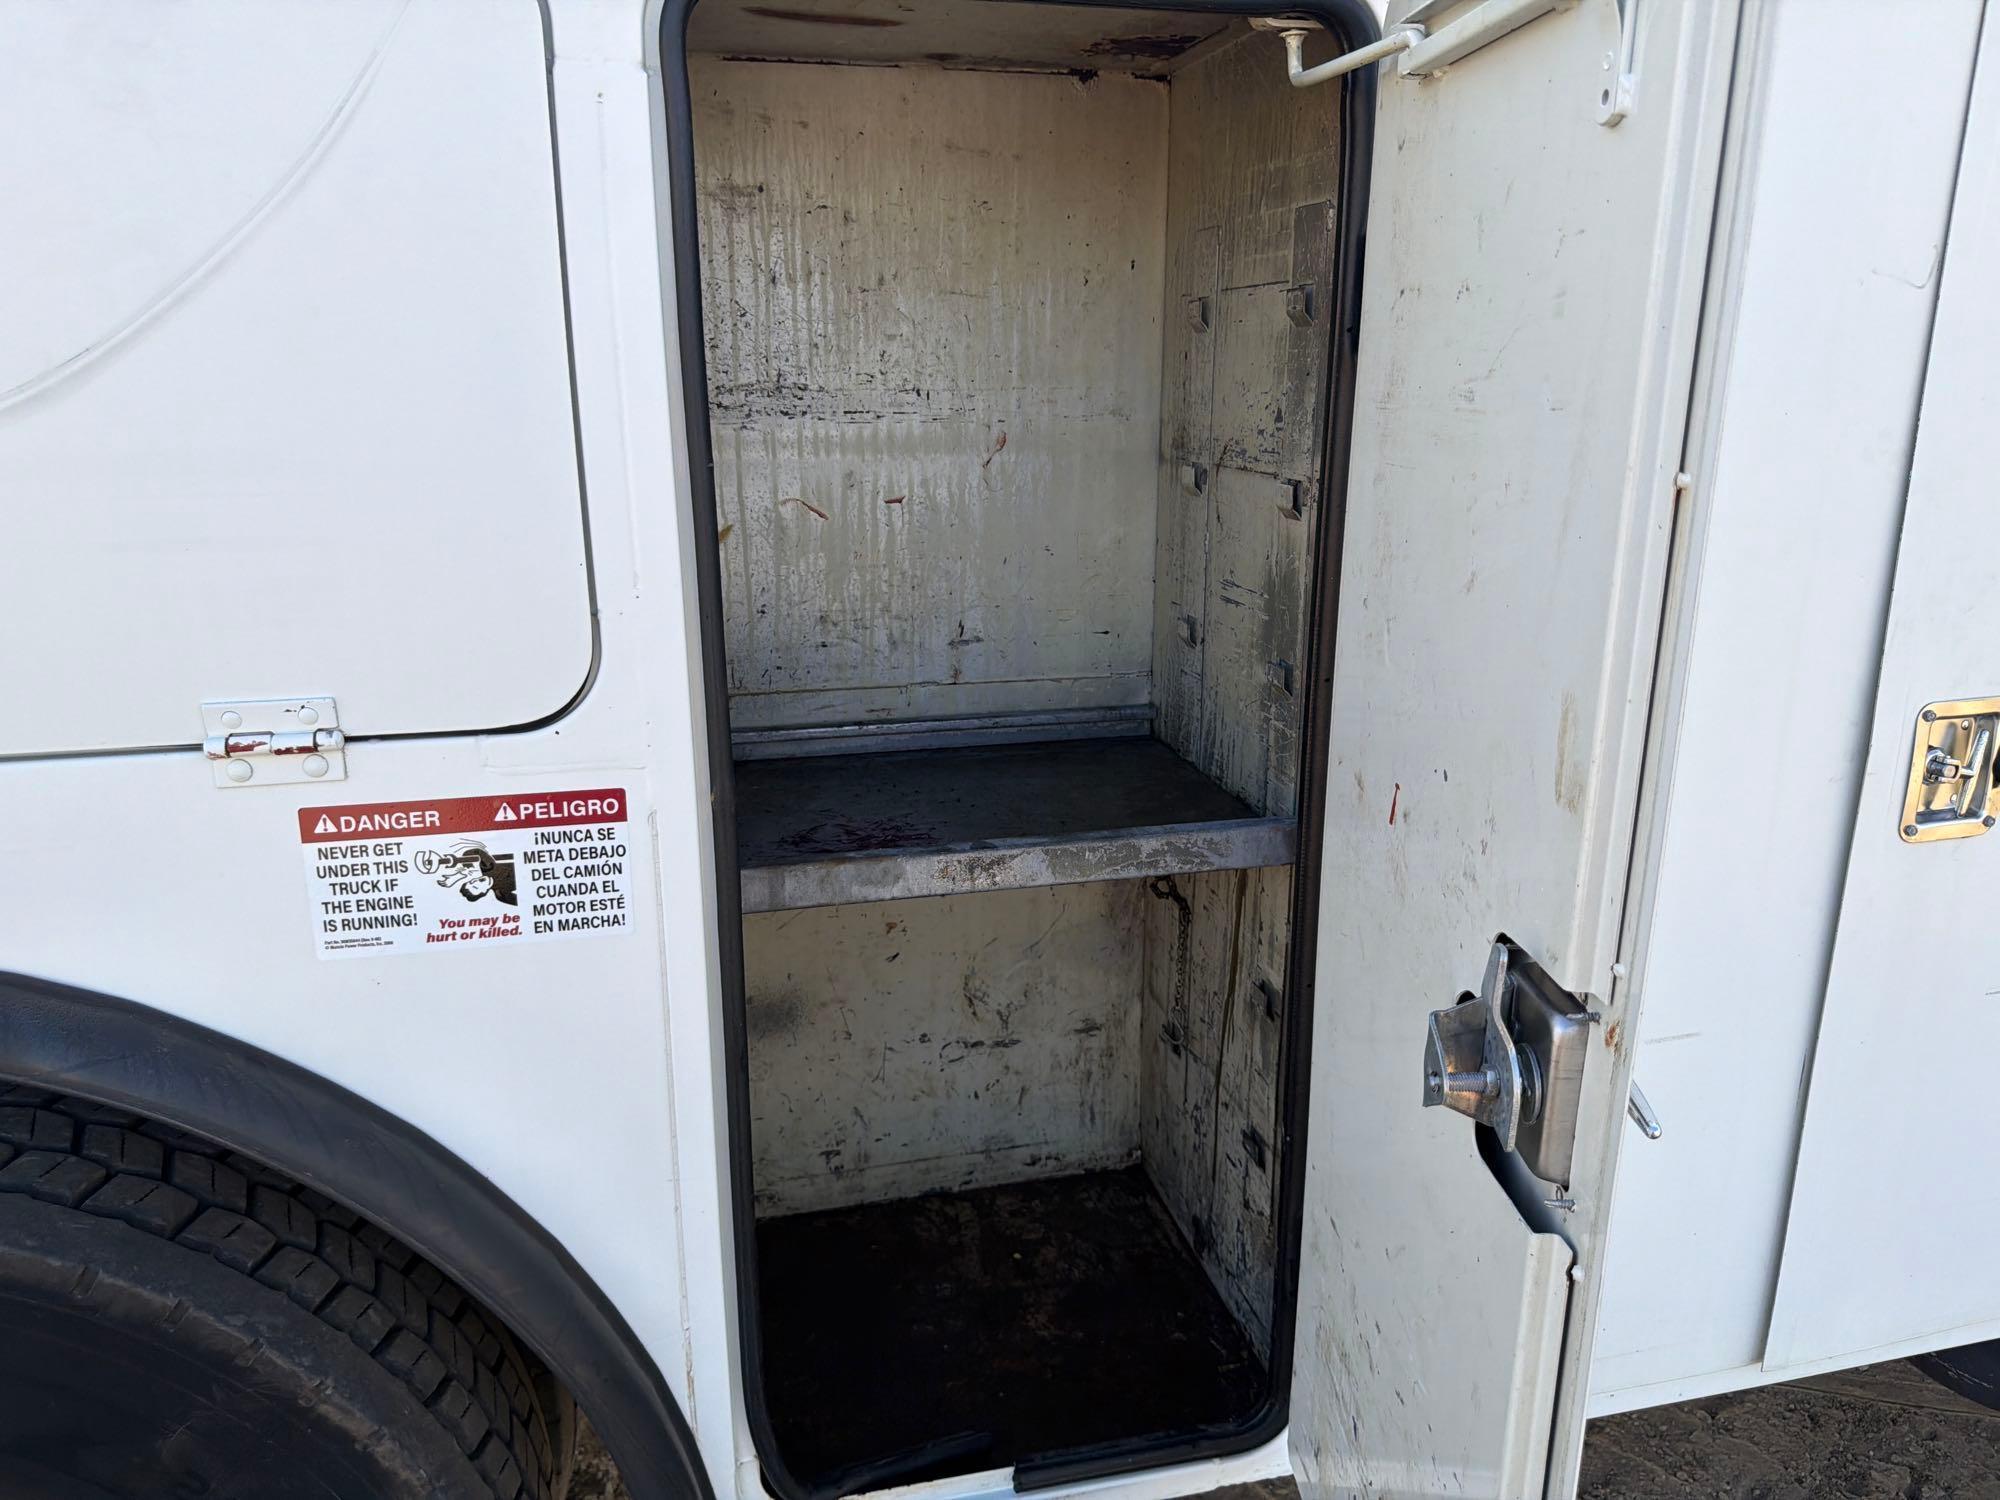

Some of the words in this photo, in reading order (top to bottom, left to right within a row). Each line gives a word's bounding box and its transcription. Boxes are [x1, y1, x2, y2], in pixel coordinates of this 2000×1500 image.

[519, 798, 619, 820] PELIGRO
[339, 810, 441, 833] DANGER
[534, 829, 594, 845] ¡NUNCA
[597, 827, 616, 841] SE
[317, 844, 369, 861] NEVER
[373, 842, 403, 856] GET
[523, 849, 565, 864] META
[568, 844, 626, 861] DEBAJO
[316, 863, 370, 879] UNDER
[373, 860, 409, 875] THIS
[531, 868, 560, 882] DEL
[563, 860, 623, 879] CAMIÓN
[329, 880, 382, 896] TRUCK
[385, 879, 398, 893] IF
[536, 882, 599, 899] CUANDA
[602, 880, 620, 893] EL
[321, 900, 352, 915] THE
[356, 895, 414, 913] ENGINE
[533, 901, 586, 917] MOTOR
[590, 894, 626, 912] ESTÉ
[323, 919, 338, 933] IS
[341, 913, 418, 932] RUNNING!
[439, 918, 466, 929] You
[468, 916, 499, 928] may
[502, 913, 521, 924] be
[534, 920, 554, 934] EN
[557, 914, 626, 932] MARCHA!
[426, 931, 458, 943] hurt
[460, 931, 476, 941] or
[478, 925, 523, 939] killed.
